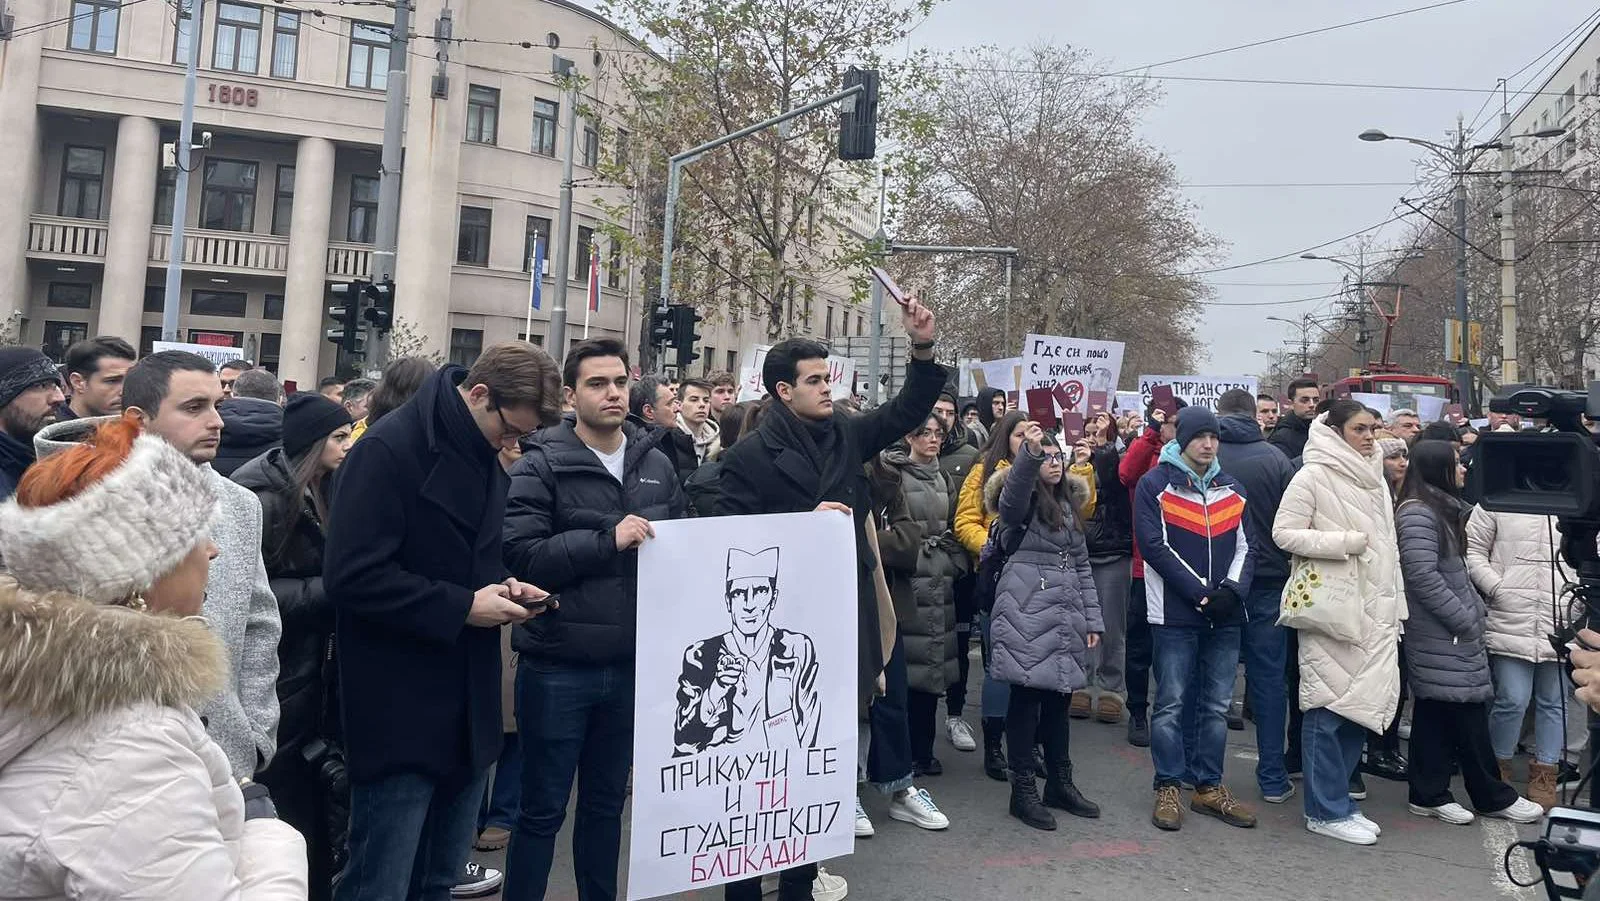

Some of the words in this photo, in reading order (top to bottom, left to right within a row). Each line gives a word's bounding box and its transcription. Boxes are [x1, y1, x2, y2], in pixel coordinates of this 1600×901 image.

[209, 83, 258, 107] 1808
[661, 748, 789, 793] ПРИКЉУЧИ
[807, 747, 837, 776] СЕ
[725, 785, 741, 812] И
[755, 778, 788, 810] ТИ
[691, 836, 808, 882] БЛОКАДИ
